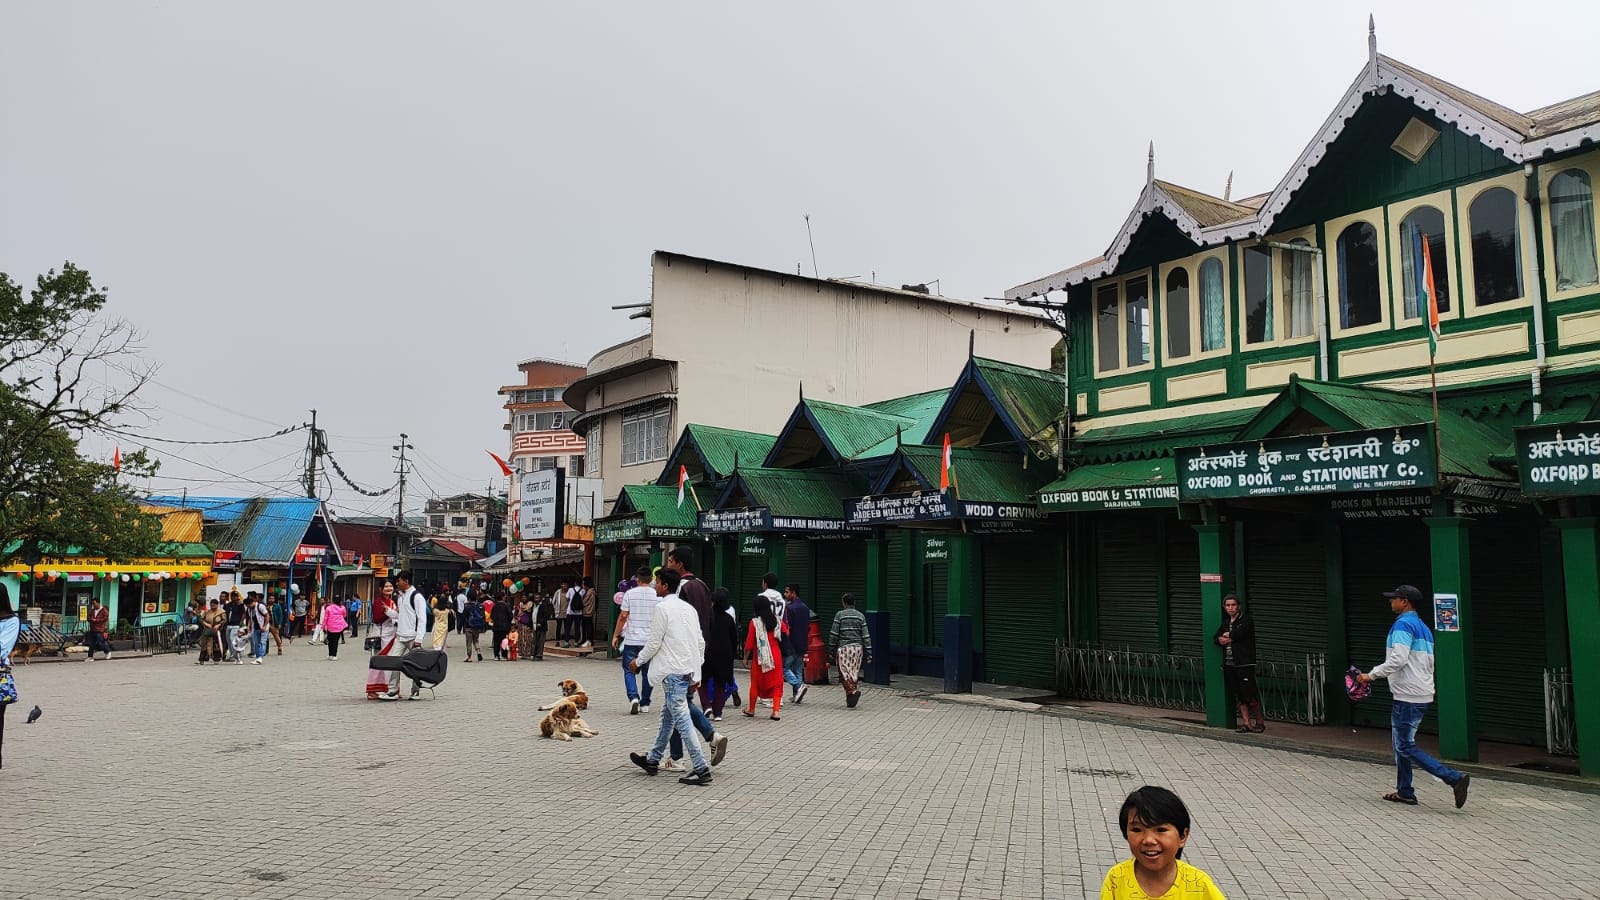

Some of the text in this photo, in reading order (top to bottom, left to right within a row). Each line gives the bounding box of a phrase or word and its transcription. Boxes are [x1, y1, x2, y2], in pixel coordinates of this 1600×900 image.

[1187, 475, 1231, 490] OXFORD
[1238, 473, 1273, 487] BOOK
[1279, 474, 1297, 482] AND
[1302, 464, 1389, 483] STATIONERY
[1397, 463, 1424, 477] Co.
[1530, 464, 1589, 482] OXFORD
[1294, 483, 1337, 492] DARJEELING
[1041, 486, 1178, 504] OXFORD BOOK & STATIONE
[1331, 495, 1431, 509] BOOKS ON DARJEELING
[883, 507, 916, 517] MULLICK
[919, 505, 927, 514] &
[928, 504, 947, 513] SON
[965, 504, 994, 517] WOOD
[998, 506, 1049, 519] CARVINGS
[1382, 509, 1410, 517] NEPAL
[752, 518, 763, 526] SON
[773, 517, 807, 530] HIMALAYAN
[807, 519, 846, 530] HANDICRAFT
[743, 535, 765, 545] Silver
[926, 537, 946, 548] Silver
